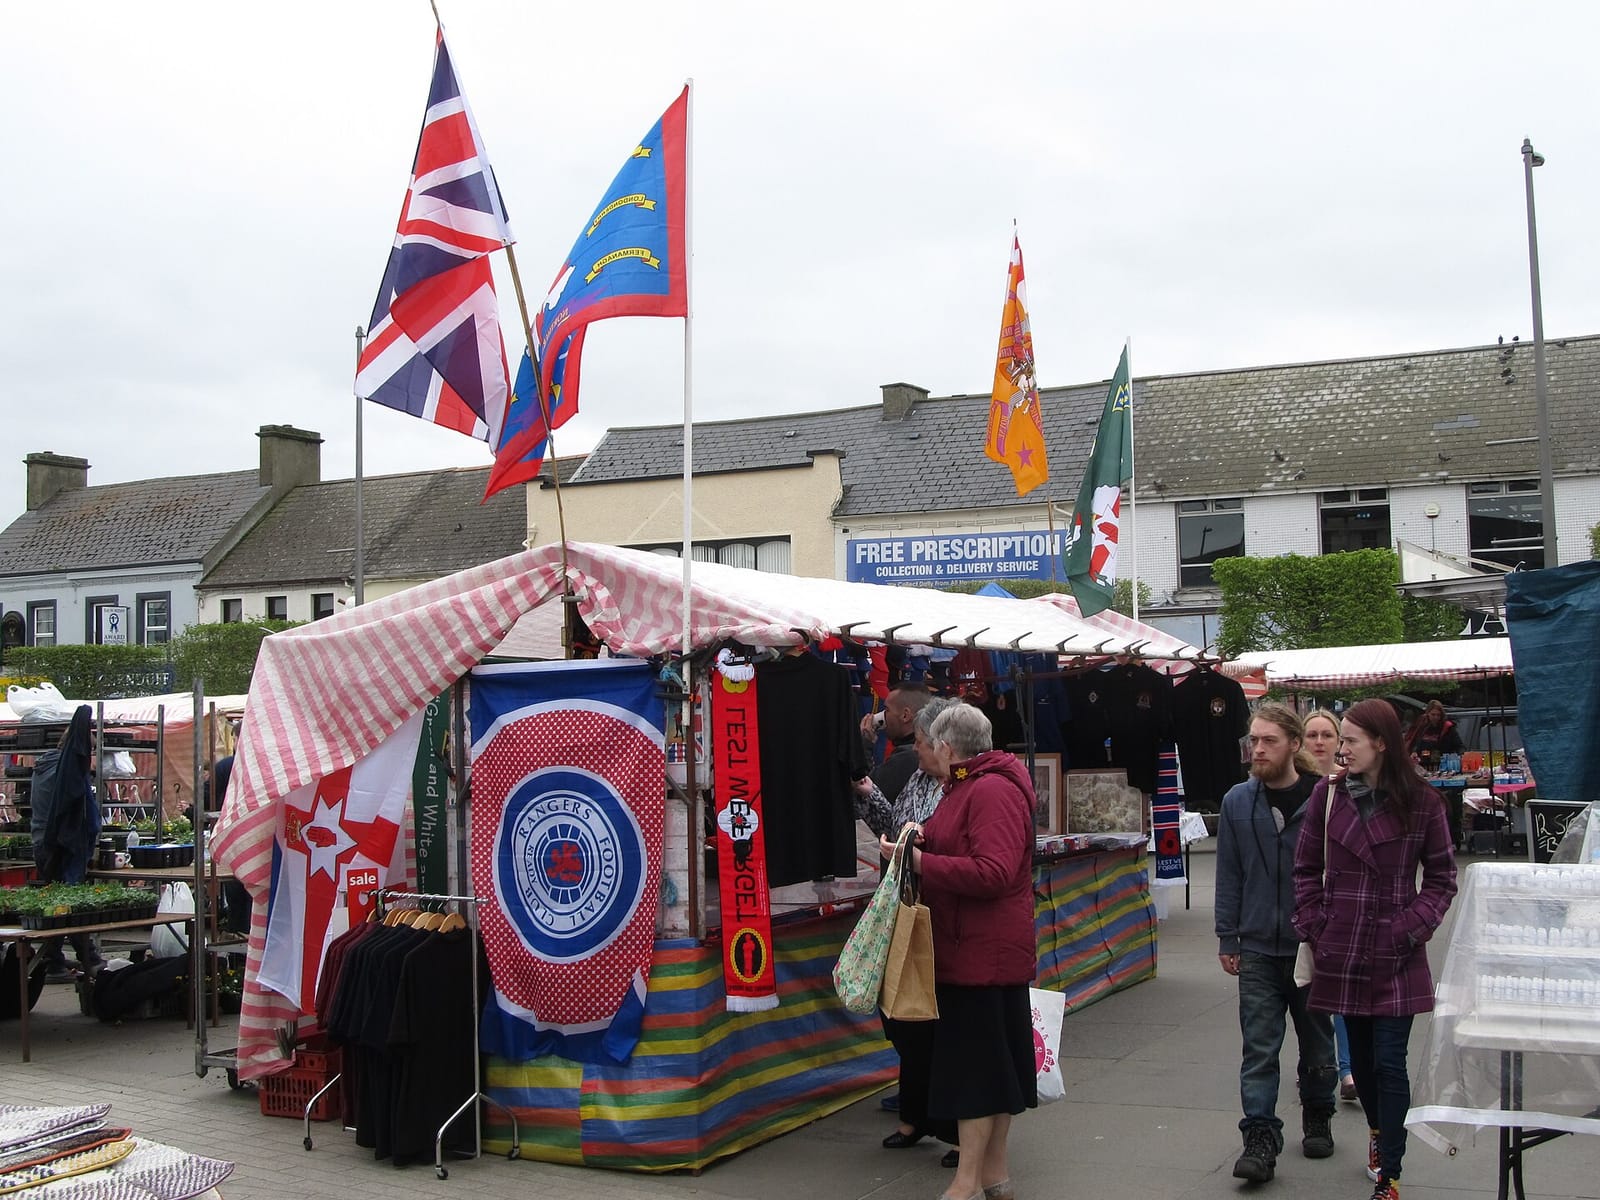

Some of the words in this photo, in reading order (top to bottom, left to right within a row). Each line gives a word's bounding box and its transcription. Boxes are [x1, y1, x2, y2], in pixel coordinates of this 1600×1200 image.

[856, 541, 904, 564] FREE
[911, 534, 1060, 562] PRESCRIPTION
[876, 565, 932, 577] COLLECTION
[936, 565, 944, 575] &
[947, 562, 993, 575] DELIVERY
[997, 560, 1039, 573] SERVICE
[426, 764, 439, 797] and
[419, 804, 439, 858] White
[518, 799, 593, 839] RANGERS
[350, 872, 376, 886] sale
[525, 845, 538, 885] READY
[569, 837, 615, 926] FOOTBALL
[525, 887, 554, 926] CLUB
